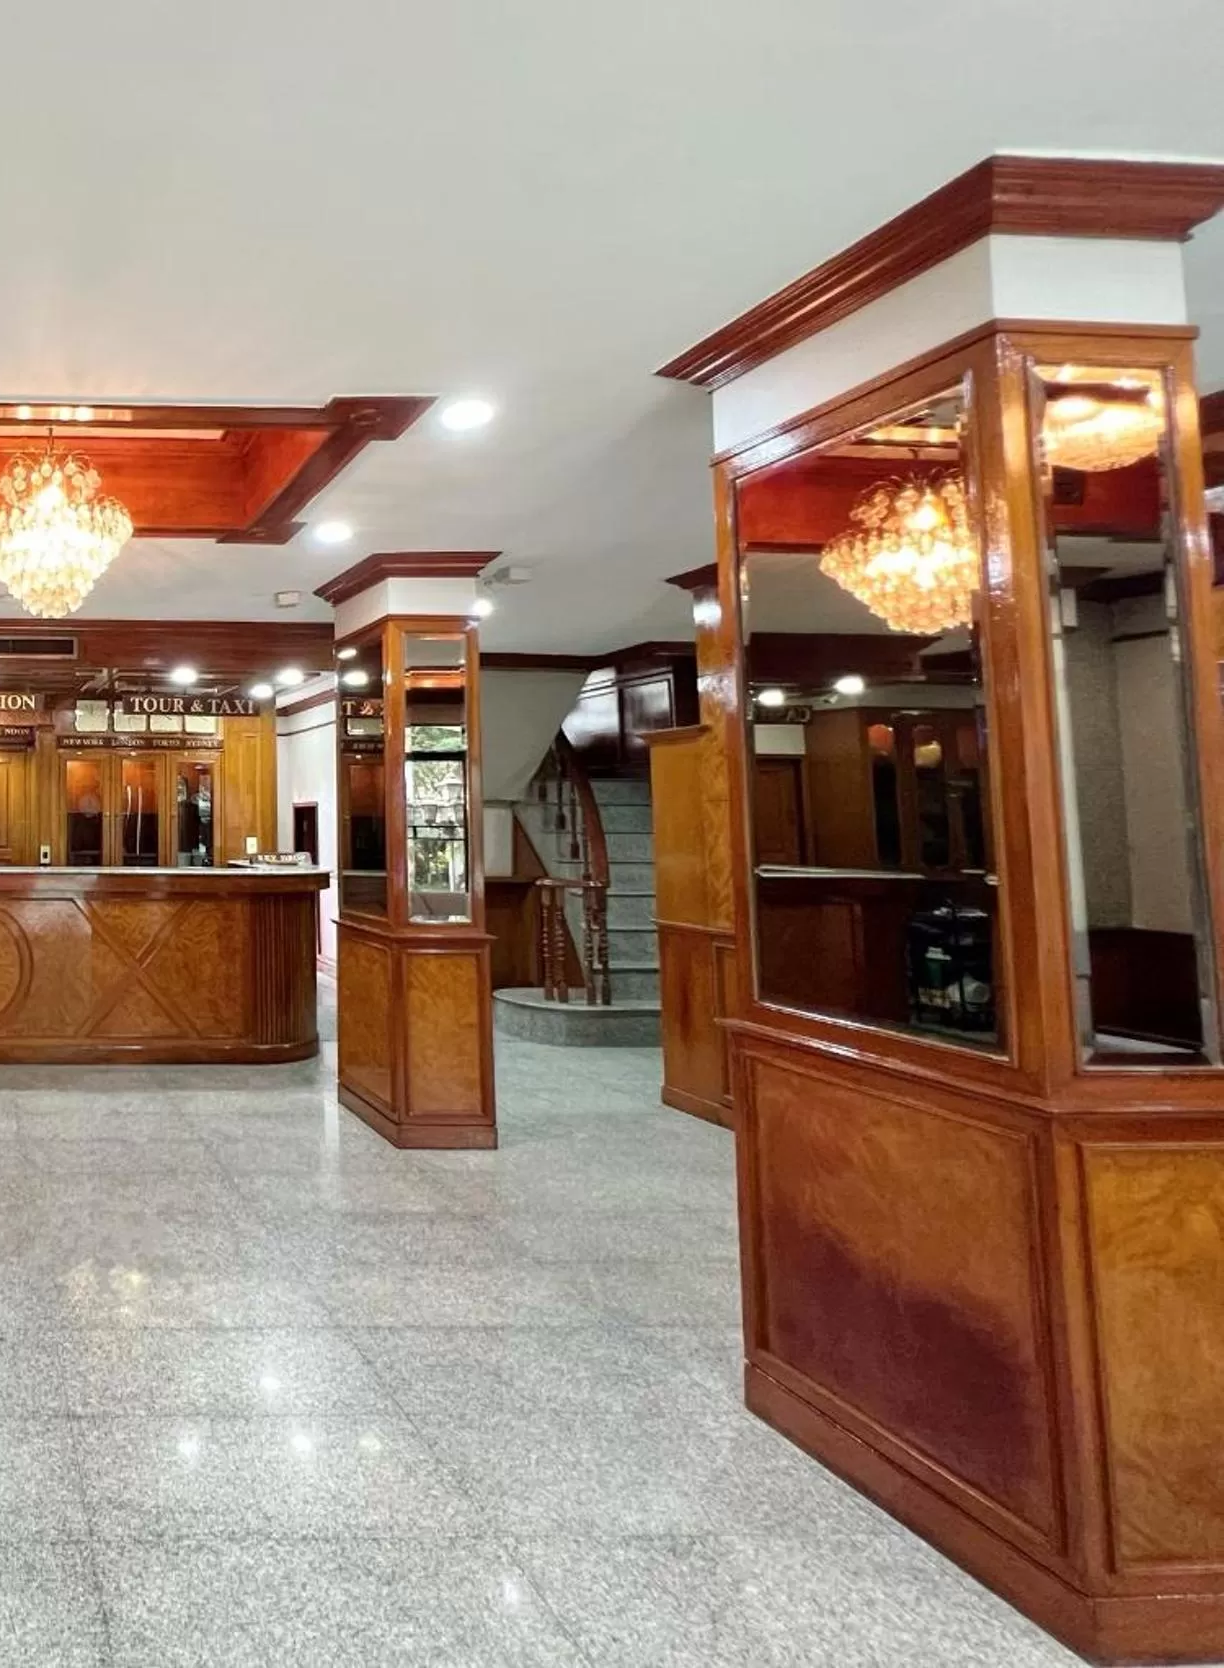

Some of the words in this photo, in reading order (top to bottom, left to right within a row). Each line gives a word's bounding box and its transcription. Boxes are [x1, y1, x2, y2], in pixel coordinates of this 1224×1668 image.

[130, 697, 184, 713] TOUR
[191, 699, 205, 712] &
[207, 699, 255, 714] TAXI
[4, 727, 30, 736] NOON
